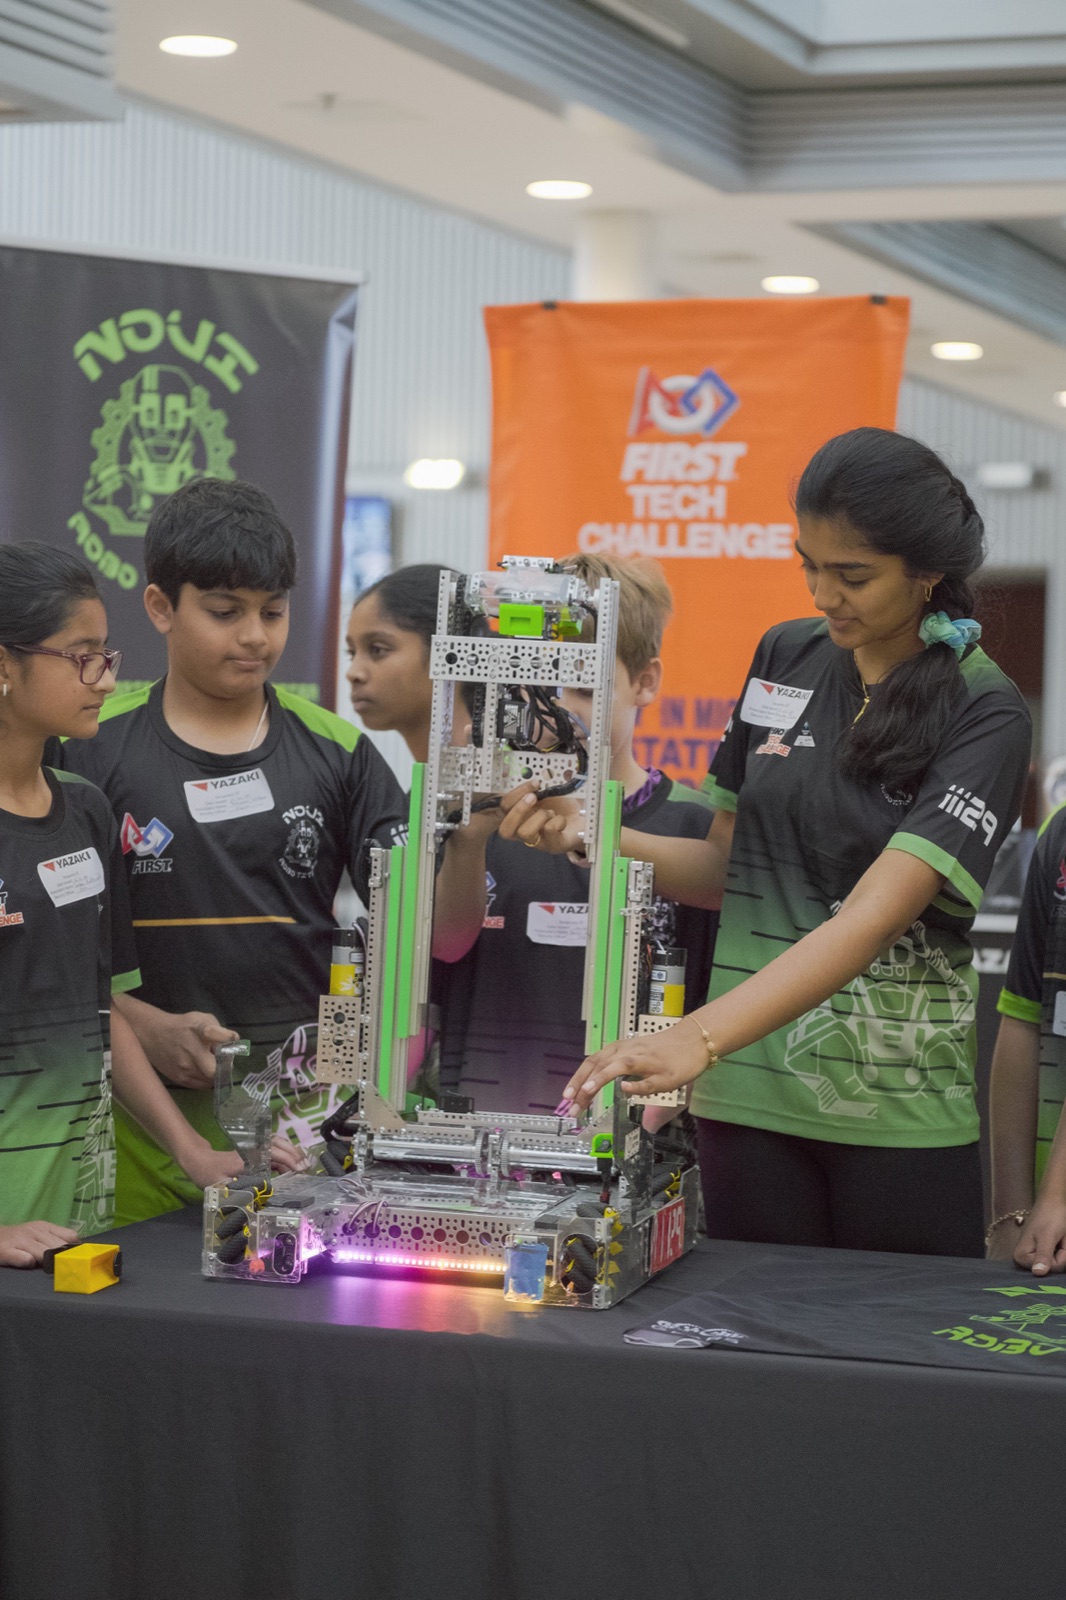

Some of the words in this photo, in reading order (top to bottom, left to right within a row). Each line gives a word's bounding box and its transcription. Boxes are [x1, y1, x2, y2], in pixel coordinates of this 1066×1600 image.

[620, 442, 747, 482] FIRST
[626, 484, 728, 520] TECH
[576, 522, 793, 559] CHALLENGE
[776, 686, 812, 700] YAZAKI
[210, 771, 260, 790] YAZAKI
[56, 851, 91, 869] YAZAKI
[132, 858, 173, 874] FIRST
[558, 905, 589, 914] YAZ
